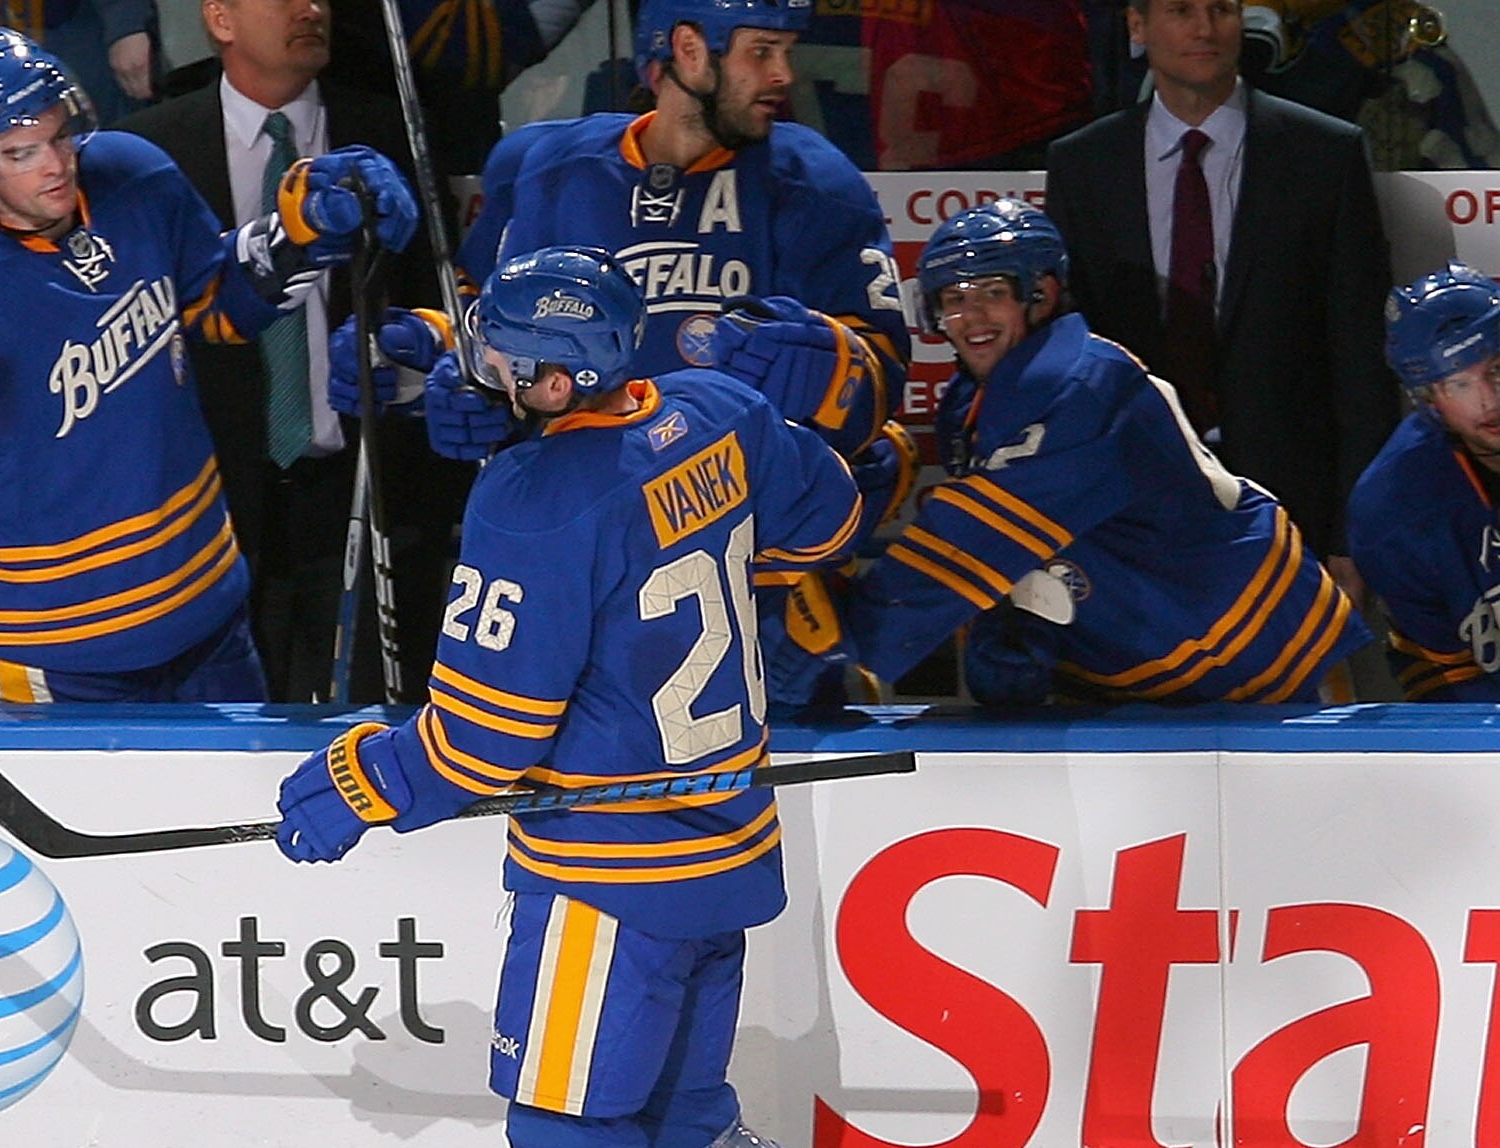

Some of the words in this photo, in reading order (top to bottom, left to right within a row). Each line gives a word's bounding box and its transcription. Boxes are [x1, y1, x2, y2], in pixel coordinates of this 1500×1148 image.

[698, 169, 743, 234] A
[532, 295, 595, 320] BUFFALO
[623, 253, 751, 299] FFALO
[860, 249, 904, 312] 2
[653, 446, 742, 535] VANEK
[442, 563, 525, 653] 26
[135, 915, 446, 1044] at&t
